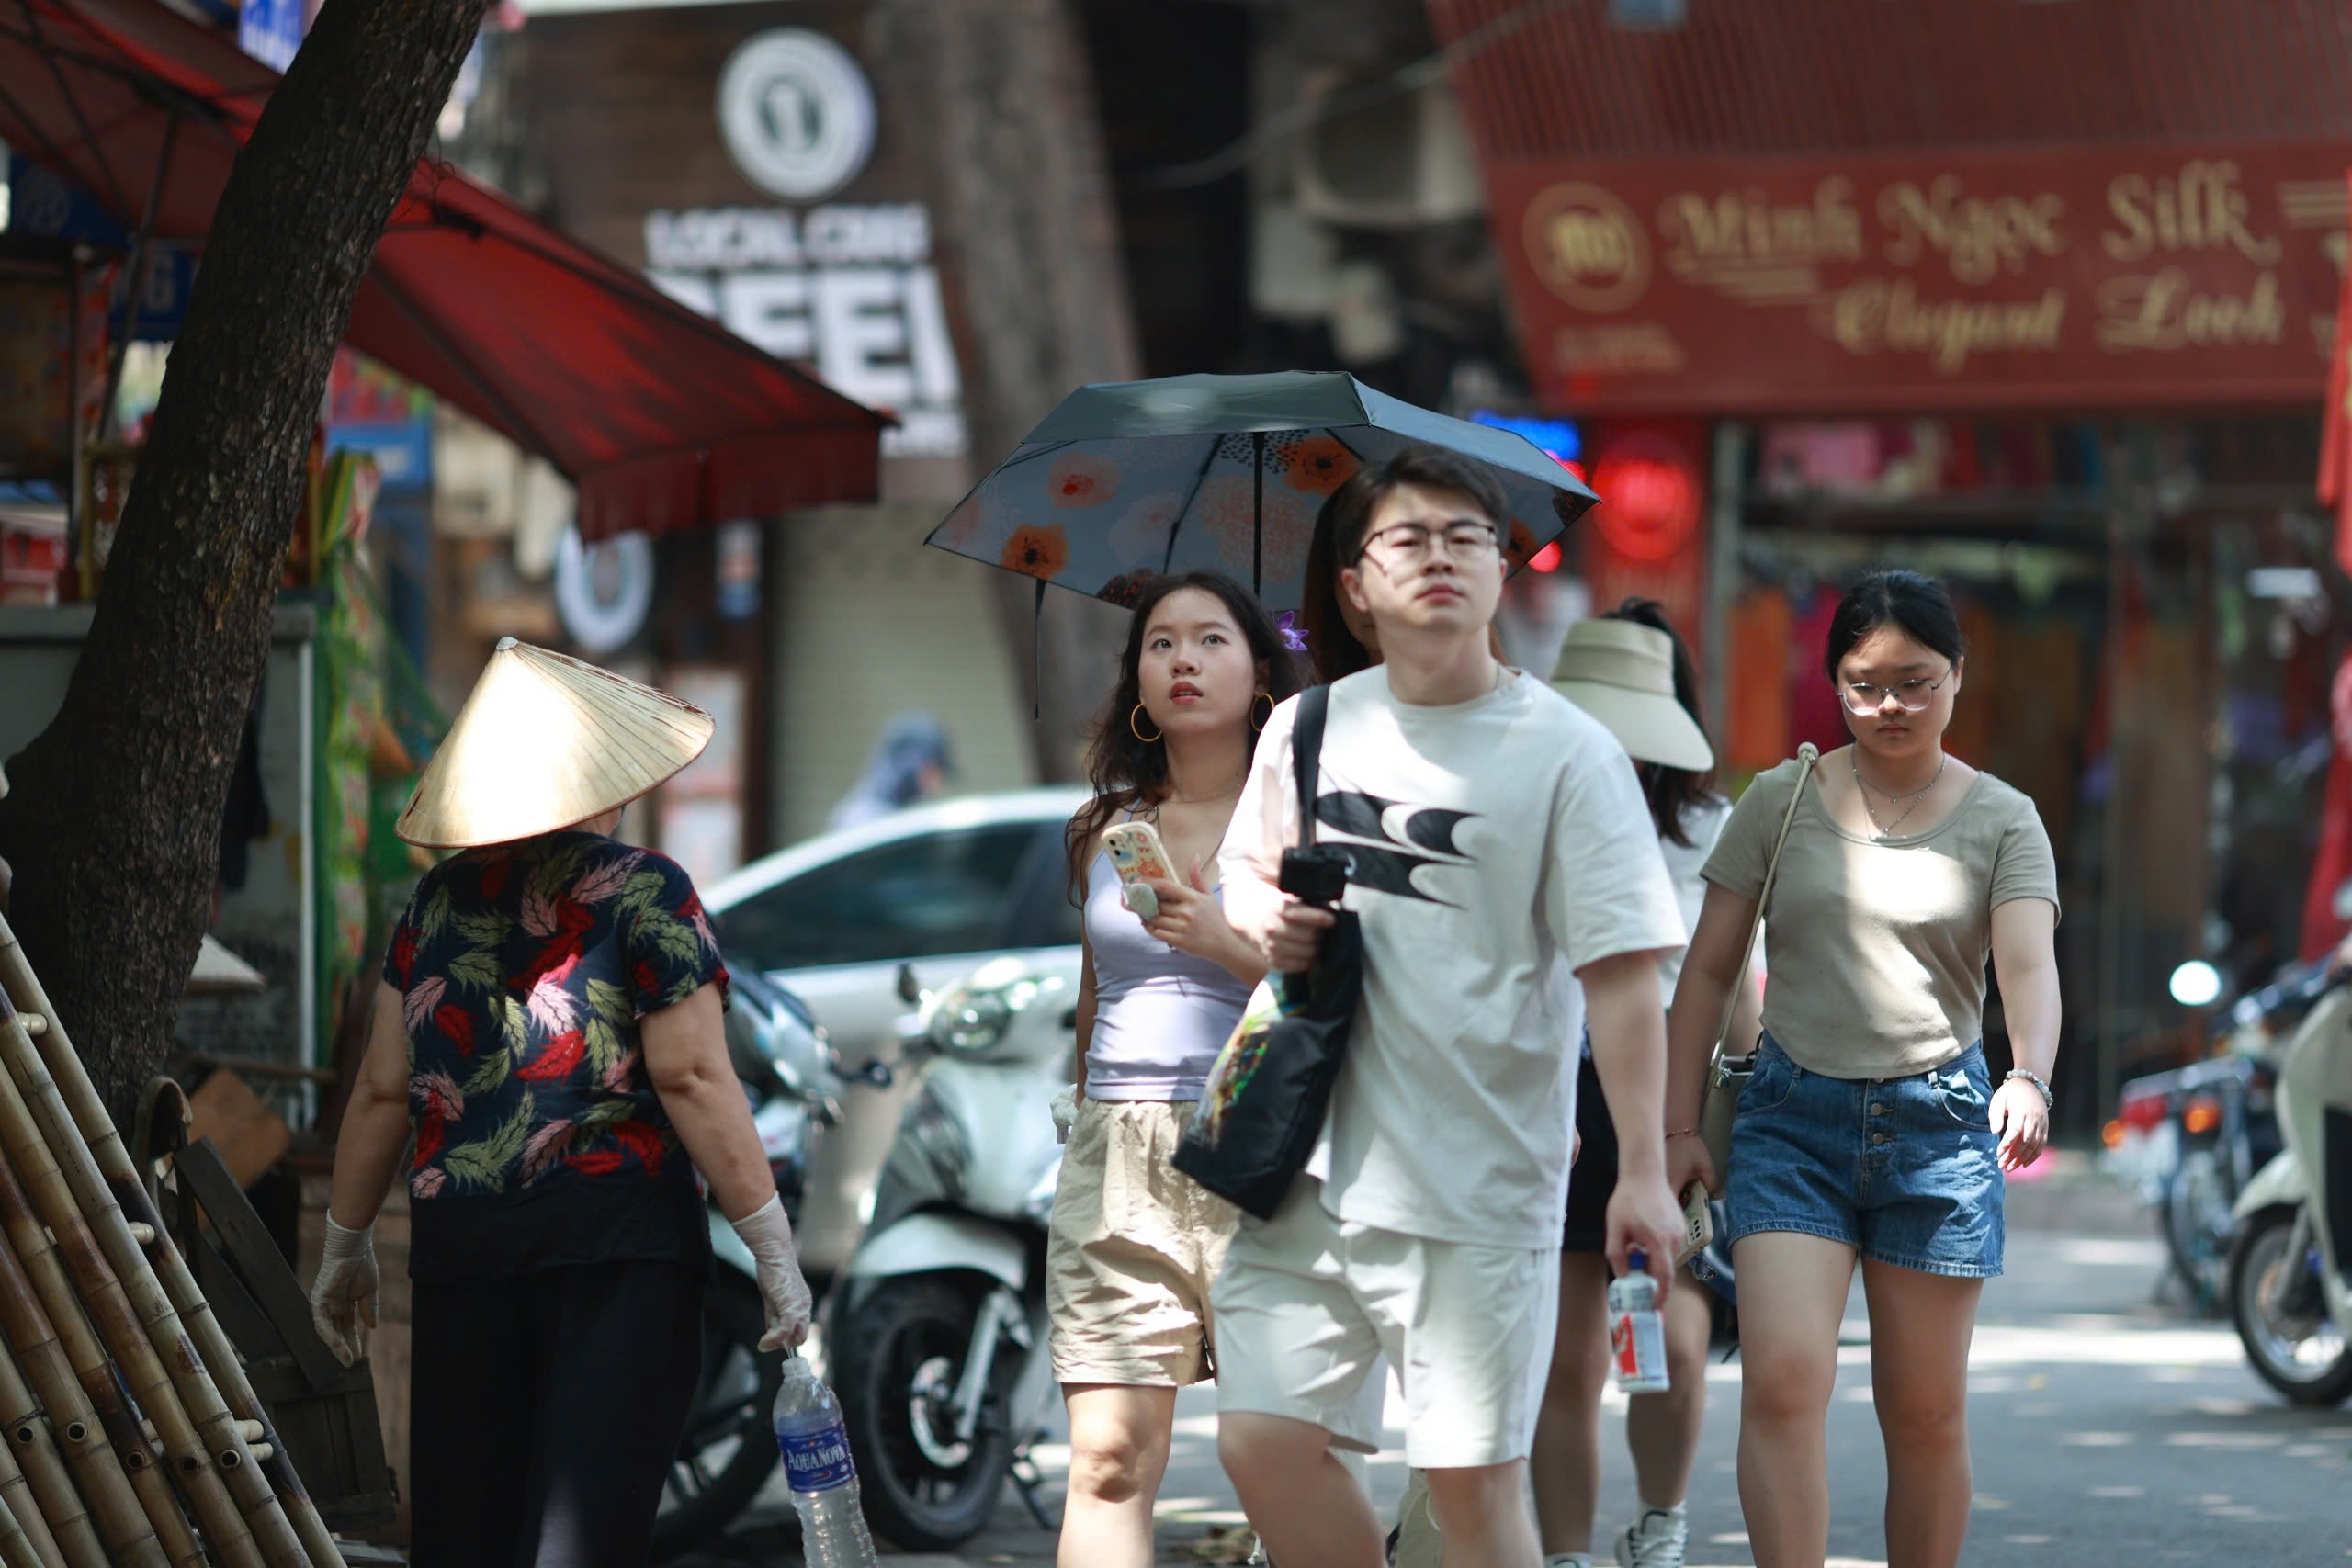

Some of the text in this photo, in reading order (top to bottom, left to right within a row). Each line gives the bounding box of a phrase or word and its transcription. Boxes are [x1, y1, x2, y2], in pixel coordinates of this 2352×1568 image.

[1658, 175, 1863, 266] Minh
[2102, 160, 2282, 265] Silk
[2096, 266, 2284, 353] Look
